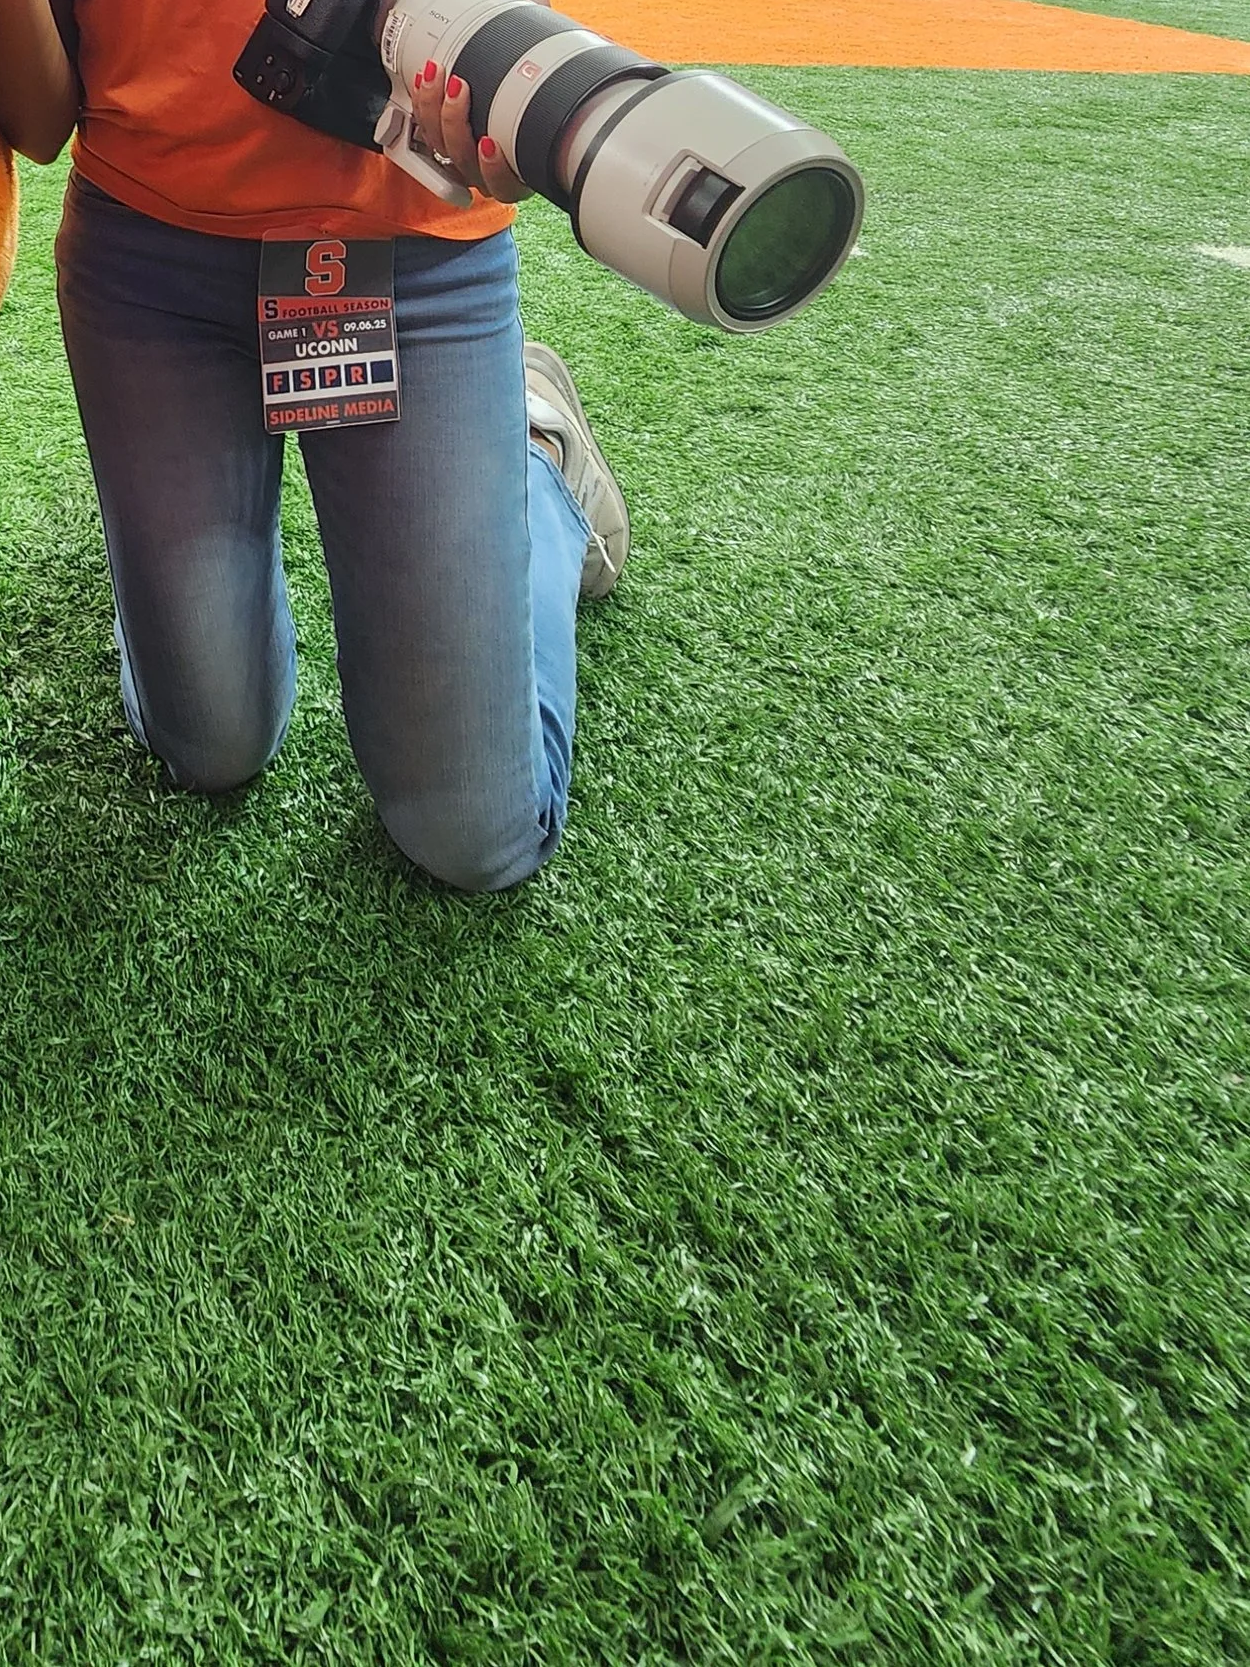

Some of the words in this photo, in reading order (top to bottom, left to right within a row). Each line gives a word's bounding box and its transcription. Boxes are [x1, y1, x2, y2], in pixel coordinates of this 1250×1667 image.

[429, 10, 451, 25] SONY
[305, 239, 347, 296] S
[264, 299, 278, 319] S
[282, 305, 339, 319] FOOTBALL
[344, 299, 390, 313] SEASON
[268, 329, 298, 341] GAME
[301, 328, 306, 338] 1
[312, 320, 339, 339] VS
[344, 319, 387, 333] 09.06.25
[295, 337, 358, 358] UCONN
[273, 375, 283, 391] F
[300, 372, 312, 389] S
[325, 369, 337, 385] P
[351, 366, 364, 383] R
[270, 404, 339, 425] SIDELINE
[344, 398, 395, 417] MEDIA
